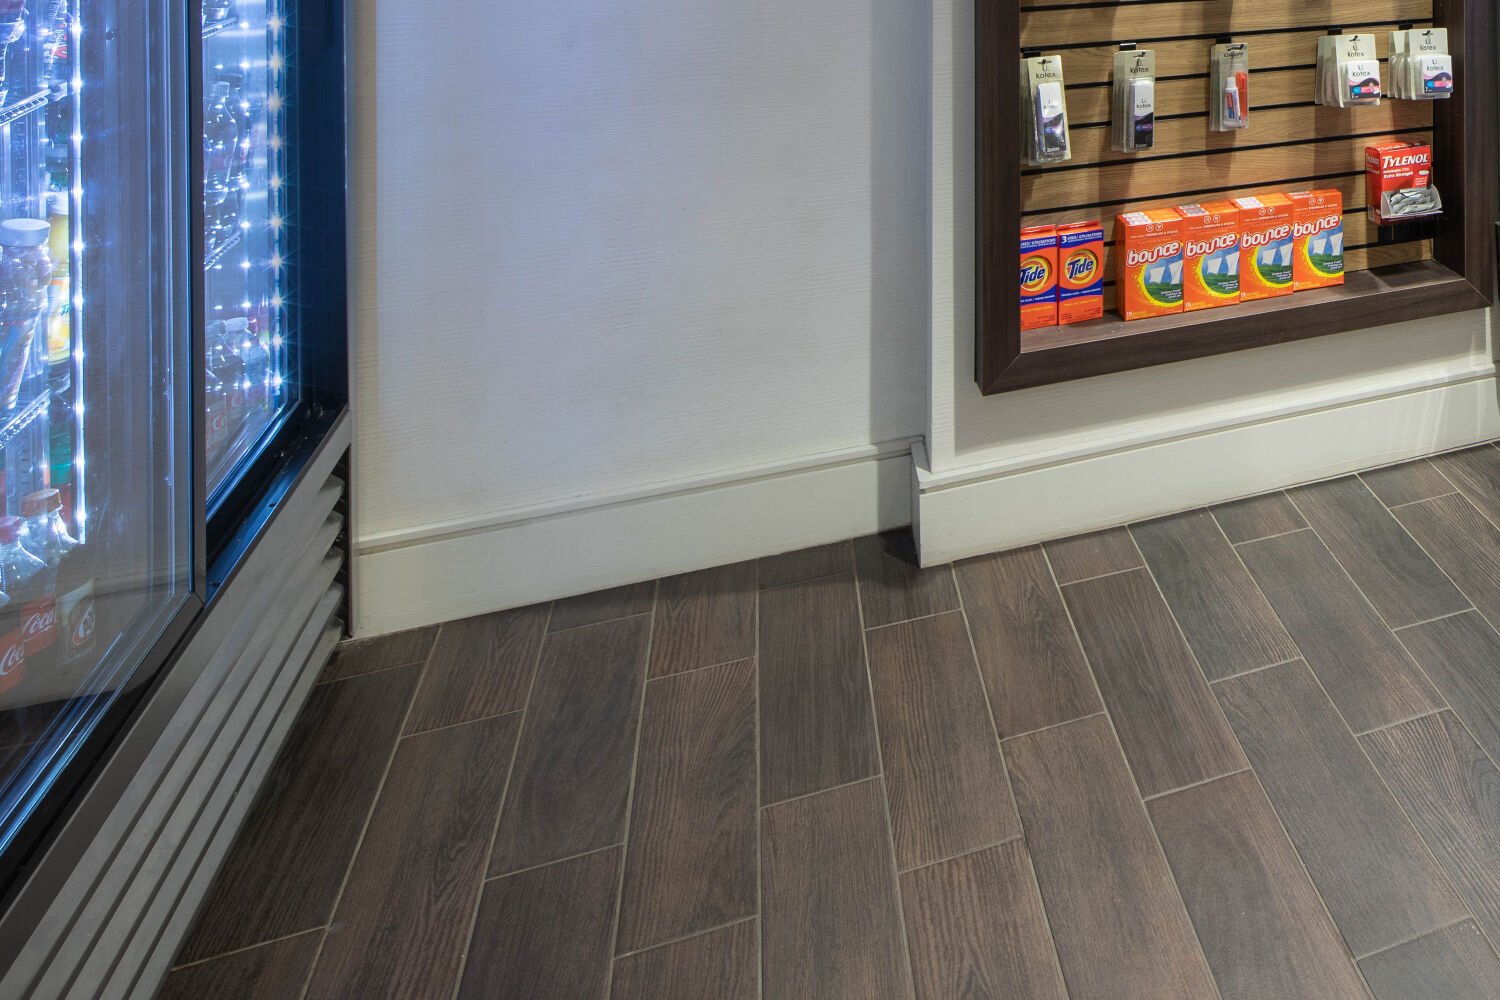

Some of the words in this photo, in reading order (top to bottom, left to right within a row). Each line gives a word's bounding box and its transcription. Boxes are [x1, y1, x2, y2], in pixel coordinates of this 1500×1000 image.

[1382, 154, 1428, 169] TYLENOL
[1242, 225, 1289, 247] bounce
[1294, 215, 1338, 237] bounce
[1128, 242, 1178, 266] bounce
[1187, 233, 1235, 256] bounce
[1021, 266, 1045, 286] Tide
[1068, 258, 1093, 279] Tide
